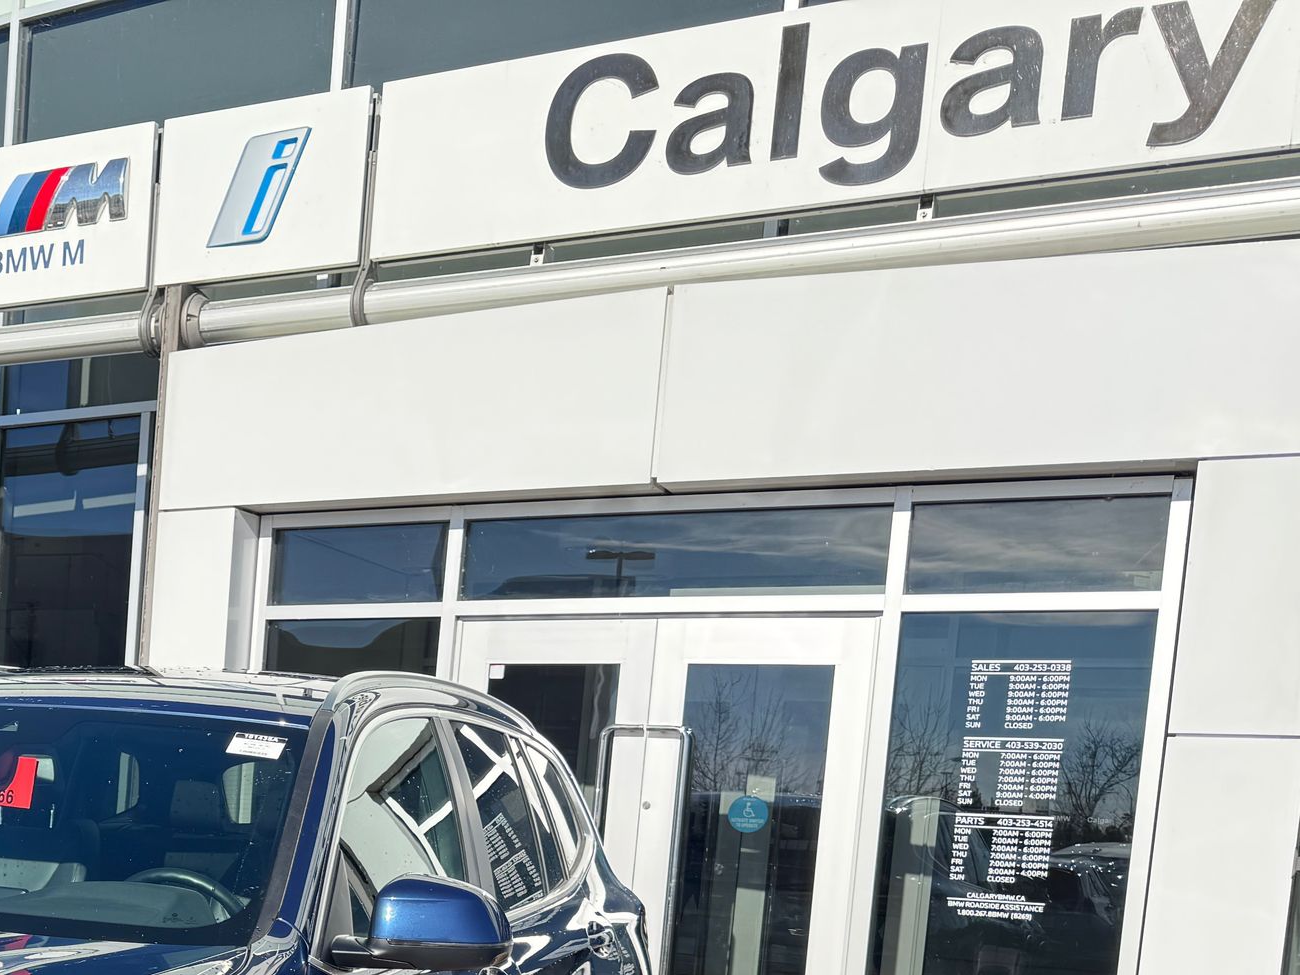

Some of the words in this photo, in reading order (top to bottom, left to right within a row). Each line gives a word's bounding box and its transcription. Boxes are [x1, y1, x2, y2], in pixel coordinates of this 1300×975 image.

[544, 0, 1277, 190] Calgary
[62, 239, 85, 266] M
[971, 663, 1001, 671] SALES
[1013, 663, 1072, 671] 403-253-0338
[970, 674, 988, 682] MON
[1007, 690, 1035, 698] 9:00AM
[1038, 714, 1066, 722] 6:00PM
[963, 740, 1001, 749] SERVICE
[1005, 741, 1063, 750] 403-539-2030
[962, 751, 980, 759] MON
[1000, 752, 1027, 760] 7:00AM
[1033, 753, 1061, 761] 6:00PM
[1032, 761, 1060, 769] 6:00PM
[959, 774, 975, 782] THU
[998, 775, 1025, 783] 7:00AM
[997, 783, 1024, 791] 7:00AM
[1029, 784, 1057, 792] 6:00PM
[957, 789, 972, 797] SAT
[1028, 792, 1056, 800] 4:00PM
[957, 797, 973, 805] SUN
[994, 799, 1024, 807] CLOSED
[955, 816, 985, 825] PARTS
[997, 818, 1053, 828] 403-253-4514
[954, 827, 971, 835] MON
[992, 829, 1019, 837] 7:00AM
[991, 836, 1019, 845] 7:00AM
[1023, 838, 1051, 846] 6:00PM
[991, 844, 1018, 852] 7:00AM
[1023, 846, 1051, 854] 6:00PM
[951, 850, 968, 858] THU
[990, 852, 1017, 860] 7:00AM
[1022, 854, 1050, 862] 6:00PM
[989, 860, 1016, 868] 7:00AM
[1021, 862, 1049, 870] 6:00PM
[950, 865, 965, 873] SAT
[988, 867, 1015, 876] 9:00AM
[1020, 869, 1048, 877] 4:00PM
[986, 875, 1015, 884] CLOSED
[965, 901, 1001, 910] ROADSIDE
[1000, 903, 1044, 913] ASSISTANCE
